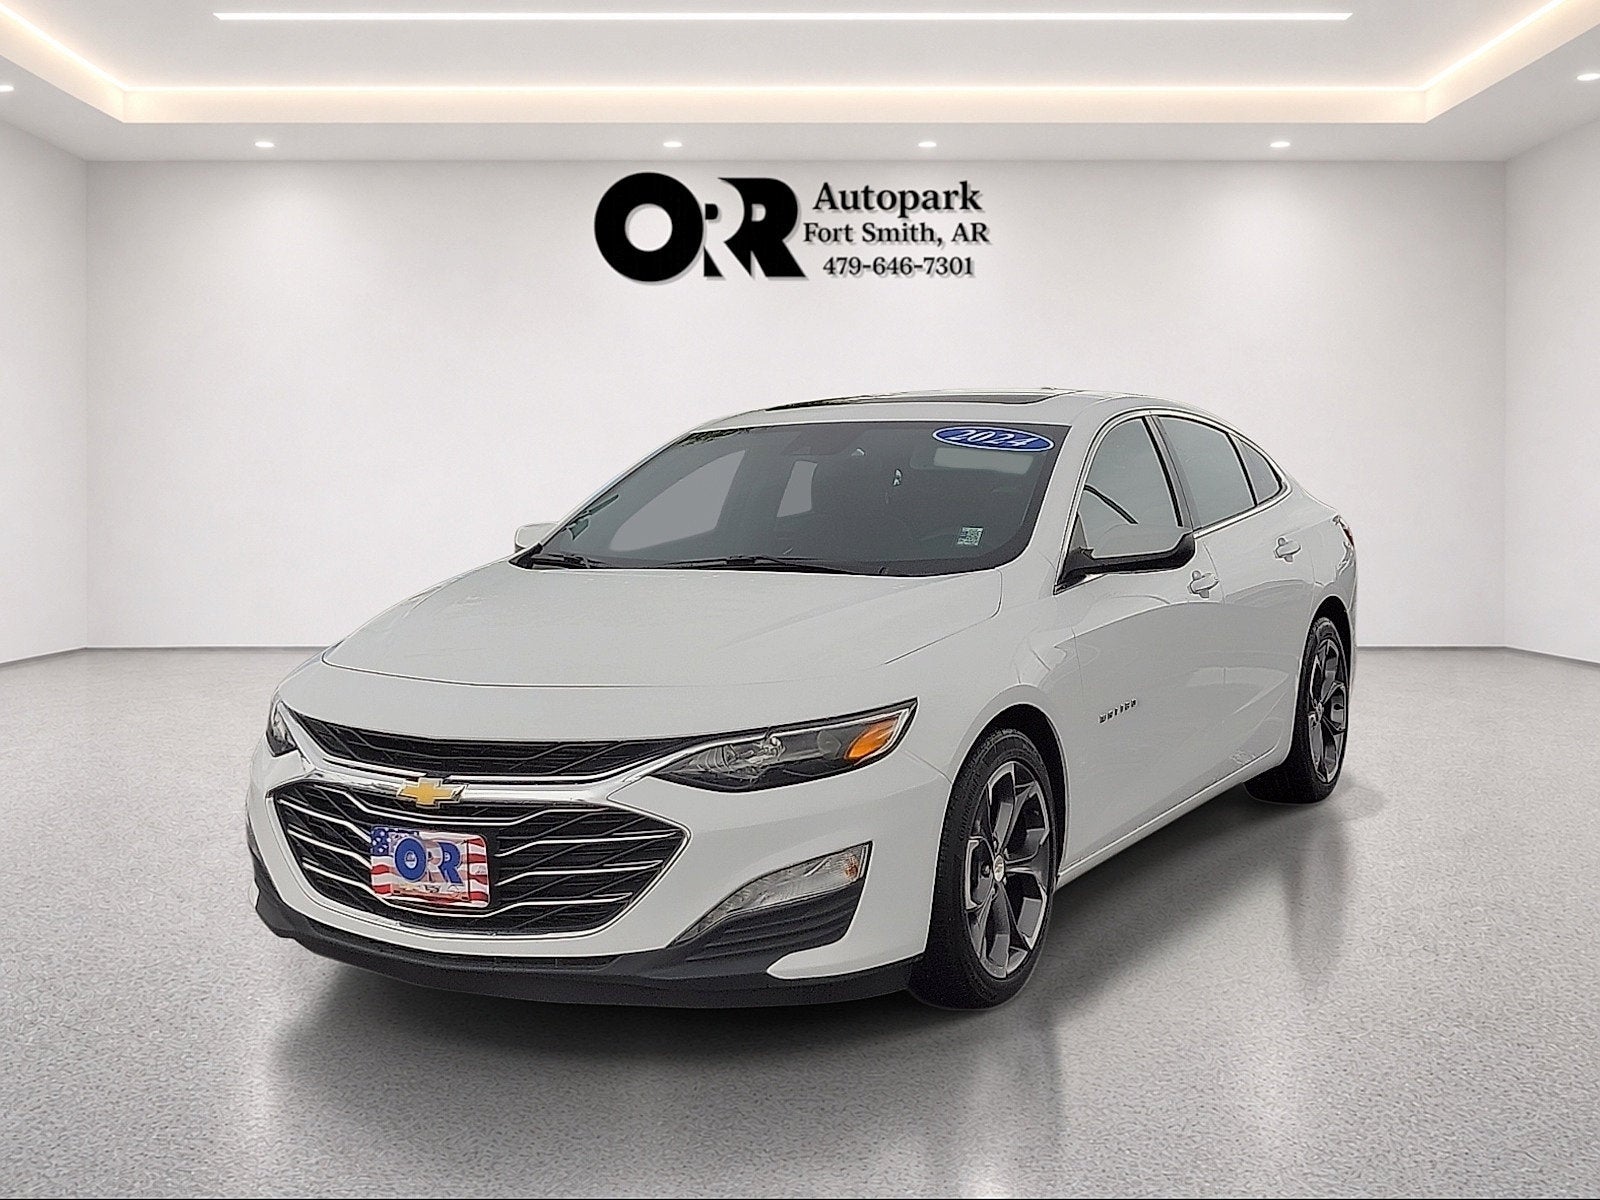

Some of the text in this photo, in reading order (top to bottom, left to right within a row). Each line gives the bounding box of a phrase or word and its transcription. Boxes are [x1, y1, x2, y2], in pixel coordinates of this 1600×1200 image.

[813, 181, 982, 218] Autopark
[594, 172, 806, 282] ORR
[803, 222, 989, 246] Fort Smith, AR
[822, 256, 974, 276] 479-646-7301
[947, 429, 1038, 447] 2024
